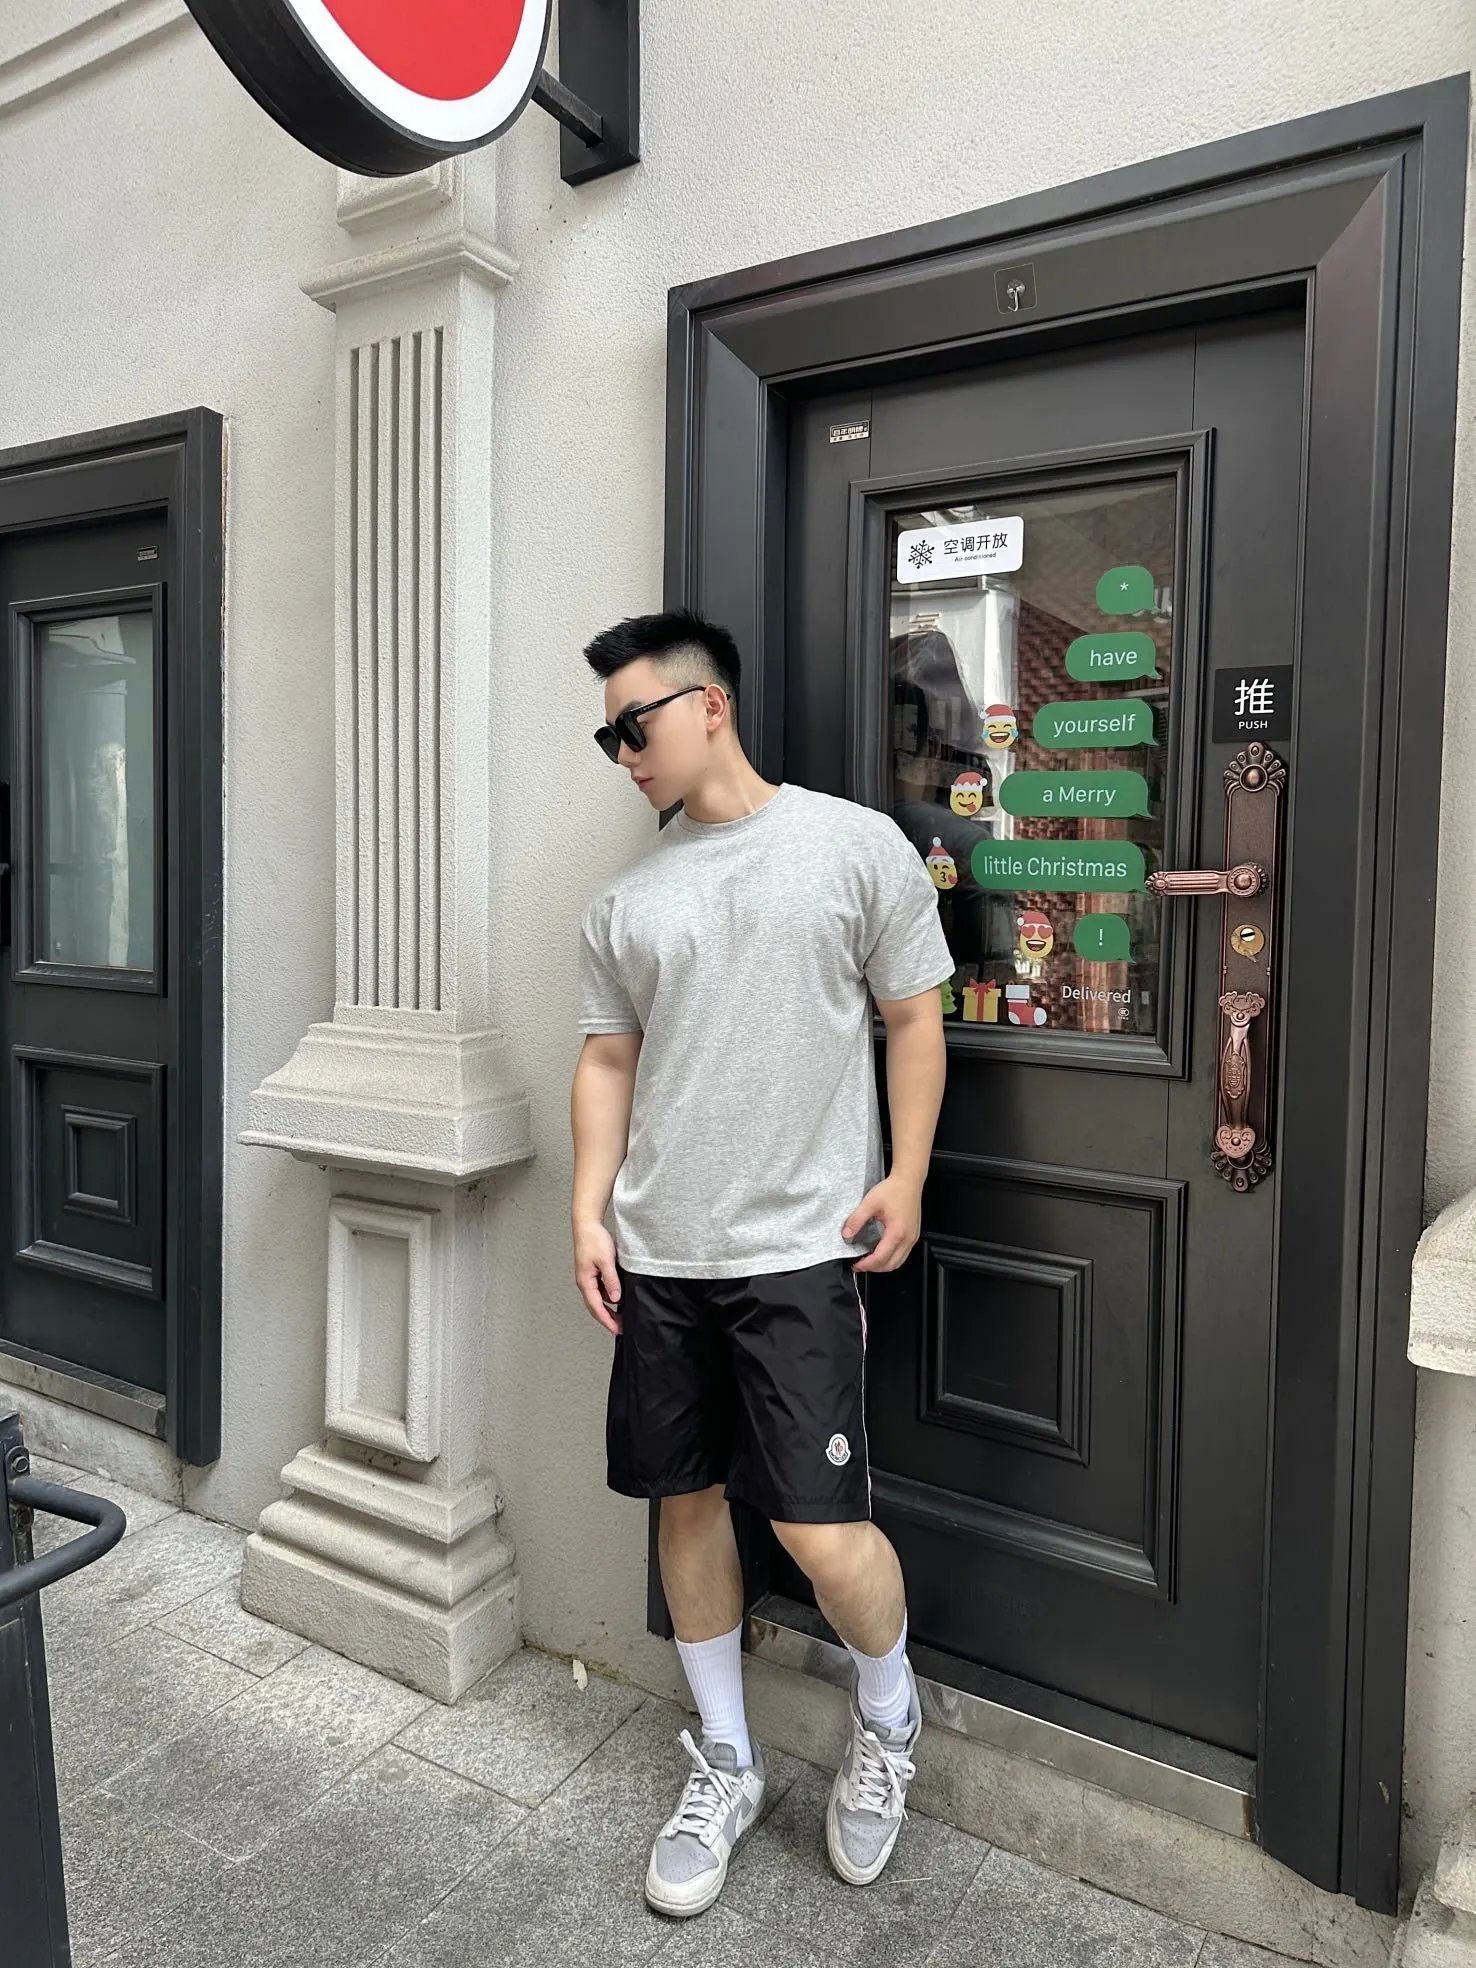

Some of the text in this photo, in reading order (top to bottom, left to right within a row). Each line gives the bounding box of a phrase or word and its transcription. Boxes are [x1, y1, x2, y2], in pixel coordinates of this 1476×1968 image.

[943, 532, 1009, 555] 空调开放
[1089, 649, 1138, 667] have
[1234, 678, 1275, 716] 推
[1053, 713, 1136, 738] yourself
[1238, 720, 1268, 730] PUSH
[1042, 786, 1117, 807] a Merry
[984, 855, 1127, 878] little Christmas
[1062, 985, 1132, 1004] Delivered
